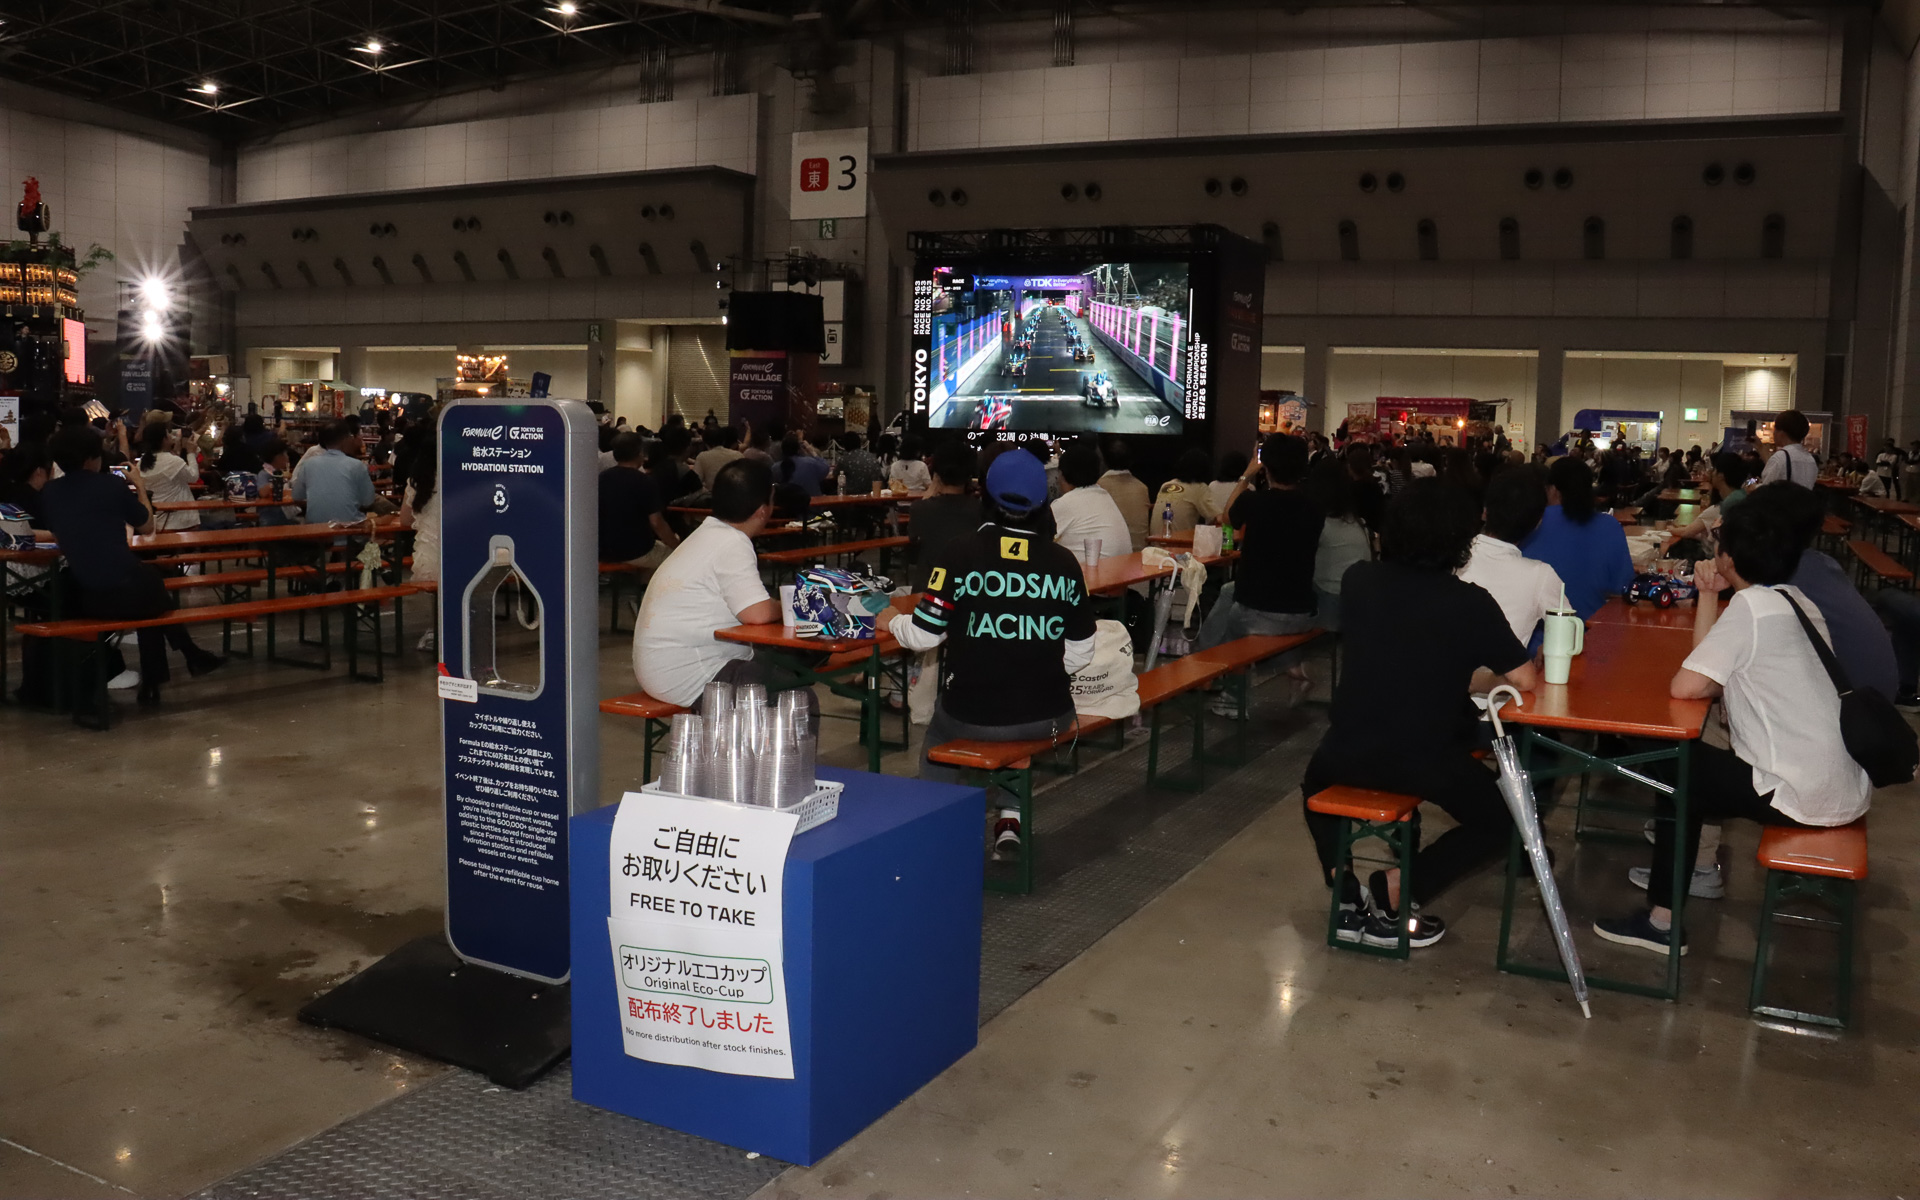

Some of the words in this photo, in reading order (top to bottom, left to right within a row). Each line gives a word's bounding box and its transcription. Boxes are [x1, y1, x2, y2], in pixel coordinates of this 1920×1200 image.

[808, 172, 821, 188] 東
[838, 156, 857, 190] 3
[1031, 279, 1052, 287] TDK
[1192, 332, 1200, 390] CHAMPIONSHIP
[1200, 343, 1208, 385] SEASON
[733, 373, 748, 381] FAN
[749, 374, 782, 382] VILLAGE
[914, 349, 928, 413] TOKYO
[472, 446, 532, 459] 給水ステーション
[462, 463, 507, 473] HYDRATION
[508, 464, 544, 474] STATION
[1008, 541, 1021, 556] 4
[966, 612, 1064, 641] RACING
[1078, 671, 1109, 682] Castrol
[1083, 685, 1114, 695] FORWARD
[654, 826, 740, 858] ご自由に
[622, 853, 766, 895] お取りください
[630, 893, 675, 913] FREE
[680, 900, 702, 918] TO
[707, 905, 755, 926] TAKE
[623, 953, 767, 984] オリジナルエコカップ
[644, 976, 690, 992] Original
[693, 983, 744, 998] Eco-Cup
[627, 997, 774, 1034] 配布終了しました
[626, 1026, 634, 1036] No
[636, 1031, 653, 1040] more
[655, 1033, 700, 1046] distribution
[702, 1040, 721, 1050] after
[723, 1044, 746, 1052] stock
[749, 1045, 786, 1056] finishes.
